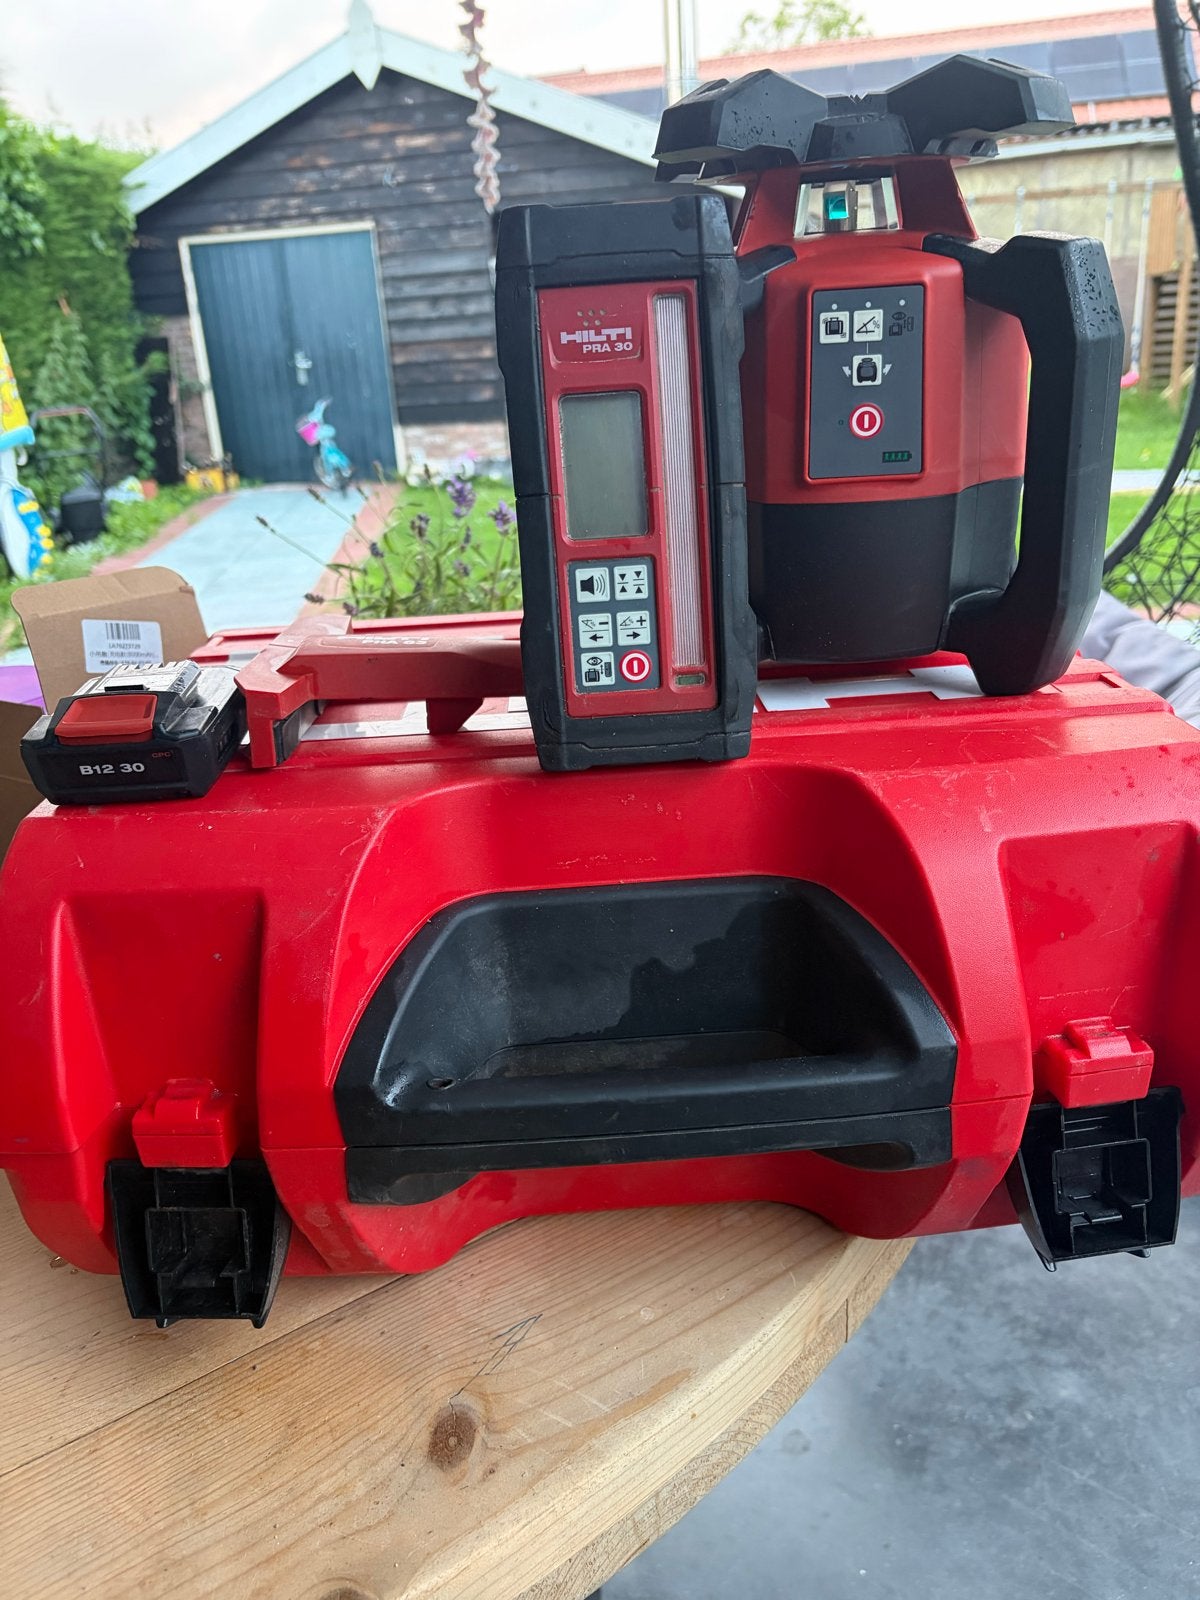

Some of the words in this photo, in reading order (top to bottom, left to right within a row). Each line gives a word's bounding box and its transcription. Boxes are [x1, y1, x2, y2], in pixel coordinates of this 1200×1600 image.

[560, 327, 633, 344] HILTI
[582, 343, 612, 354] PRA
[614, 341, 634, 352] 30
[79, 764, 115, 775] B12
[119, 762, 145, 773] 30
